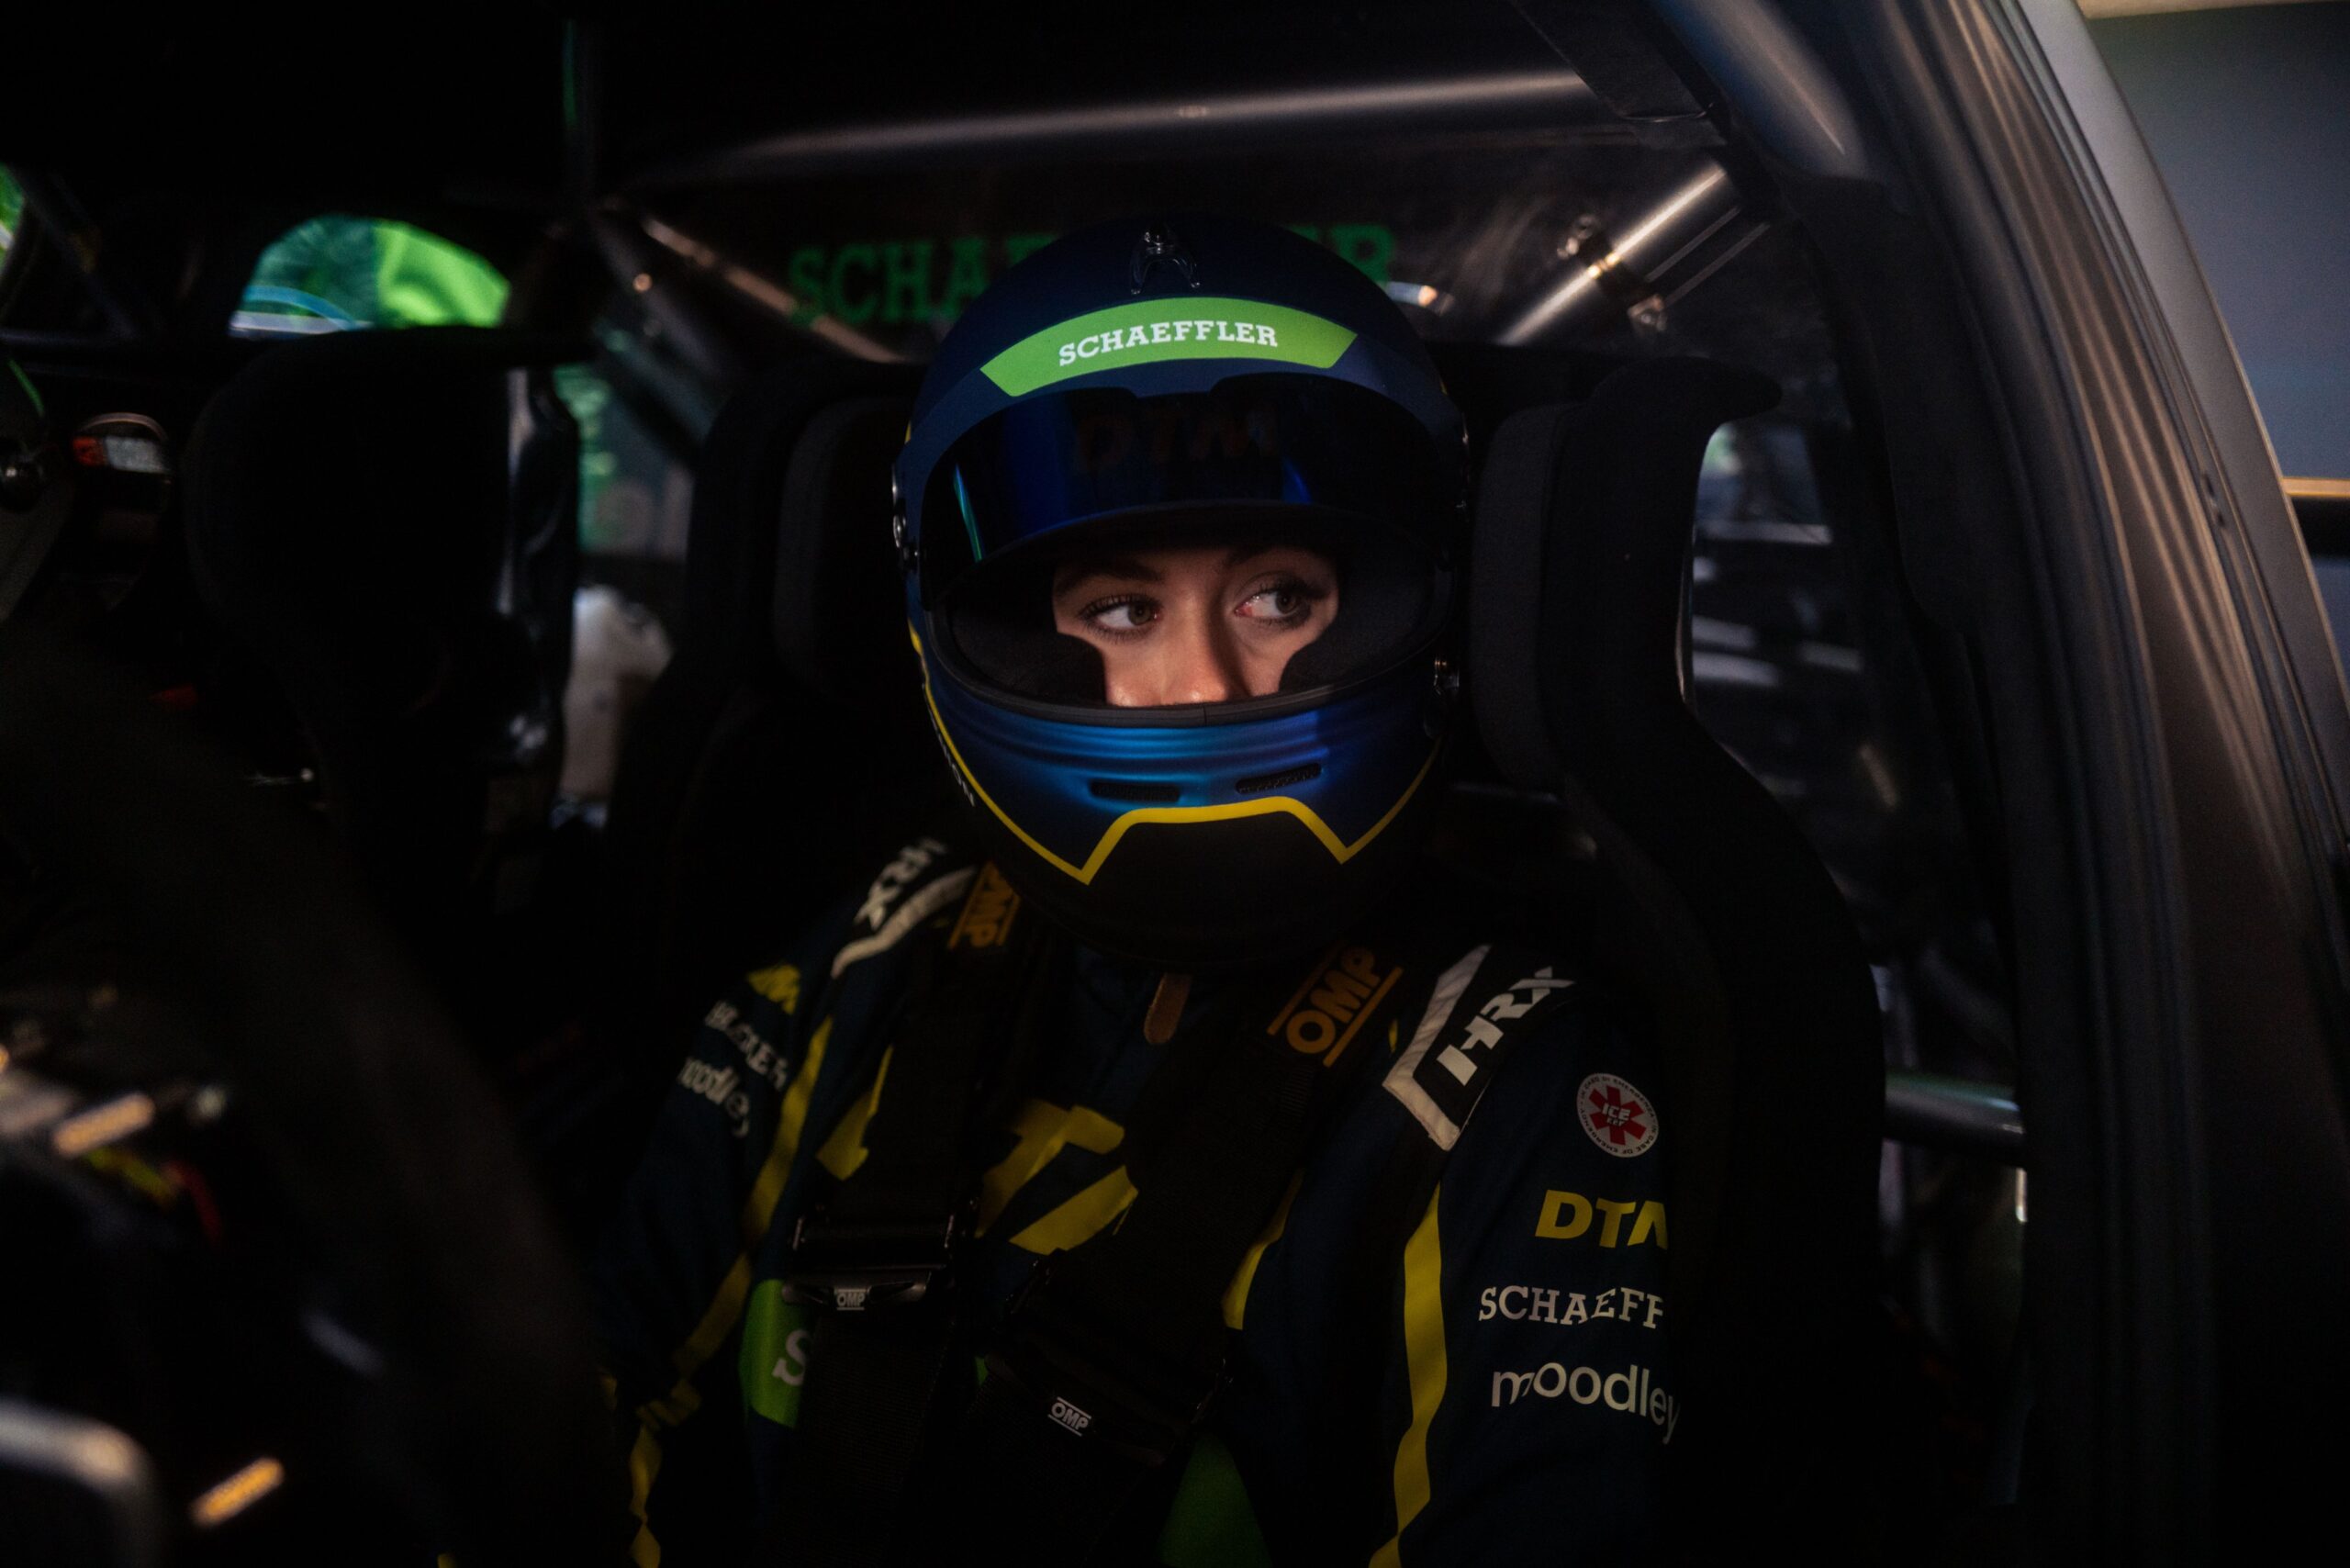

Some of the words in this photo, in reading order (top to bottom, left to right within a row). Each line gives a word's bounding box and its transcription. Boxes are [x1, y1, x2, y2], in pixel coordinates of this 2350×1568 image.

[1058, 319, 1278, 367] SCHAEFFLER
[1285, 946, 1381, 1055] OMP
[1436, 965, 1577, 1087] HRX
[1579, 1108, 1619, 1154] EMERGENCY
[1602, 1103, 1631, 1121] ICE
[1635, 1136, 1654, 1152] CASE
[836, 1293, 866, 1307] OMP
[1478, 1285, 1665, 1329] SCHAEFF
[1051, 1402, 1089, 1430] OMP
[1491, 1361, 1681, 1446] moodley
